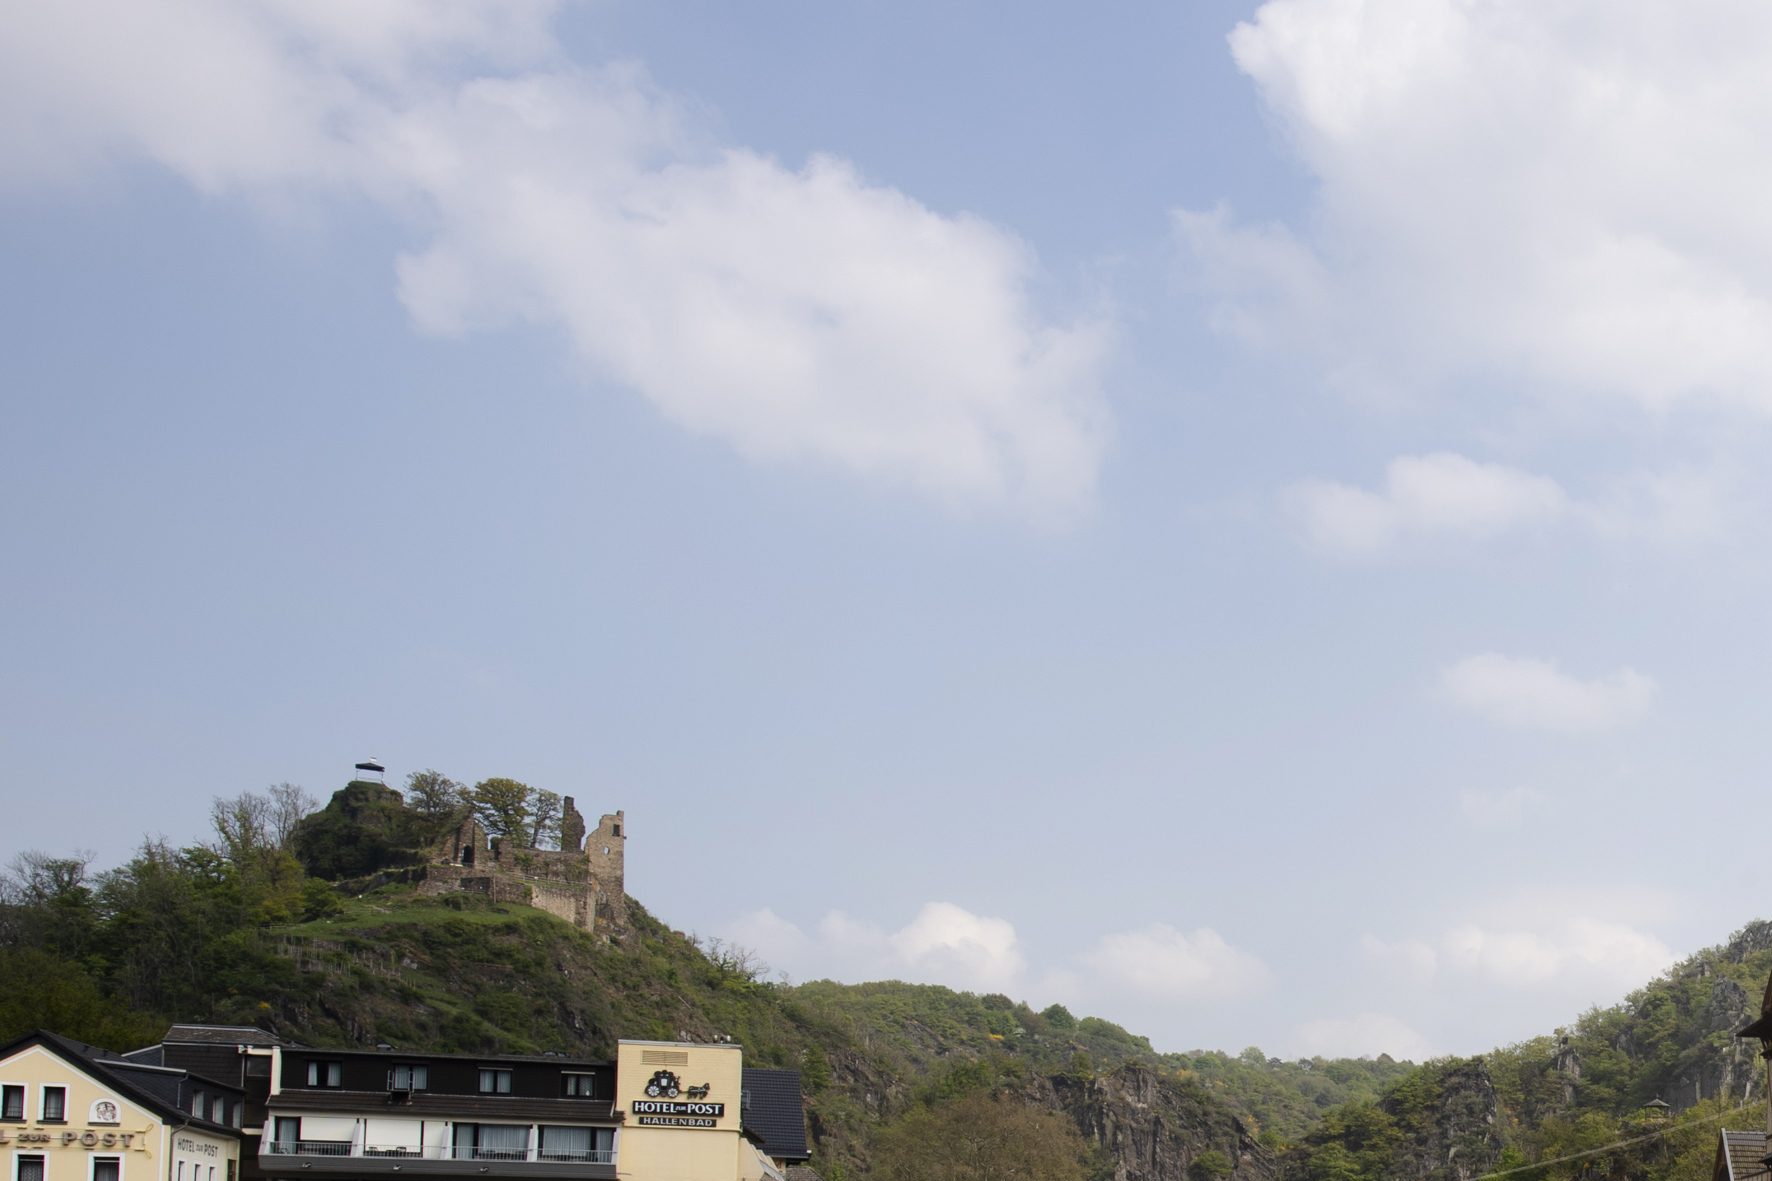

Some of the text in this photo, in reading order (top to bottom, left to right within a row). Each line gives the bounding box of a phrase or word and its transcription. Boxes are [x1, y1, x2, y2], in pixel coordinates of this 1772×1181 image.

[634, 1102, 677, 1113] HOTEL
[687, 1103, 722, 1114] POST
[643, 1117, 713, 1127] HALLENBAD
[18, 1133, 51, 1143] ZUR
[62, 1131, 135, 1148] POST
[177, 1138, 195, 1153] HOTEL
[204, 1144, 218, 1157] POST
